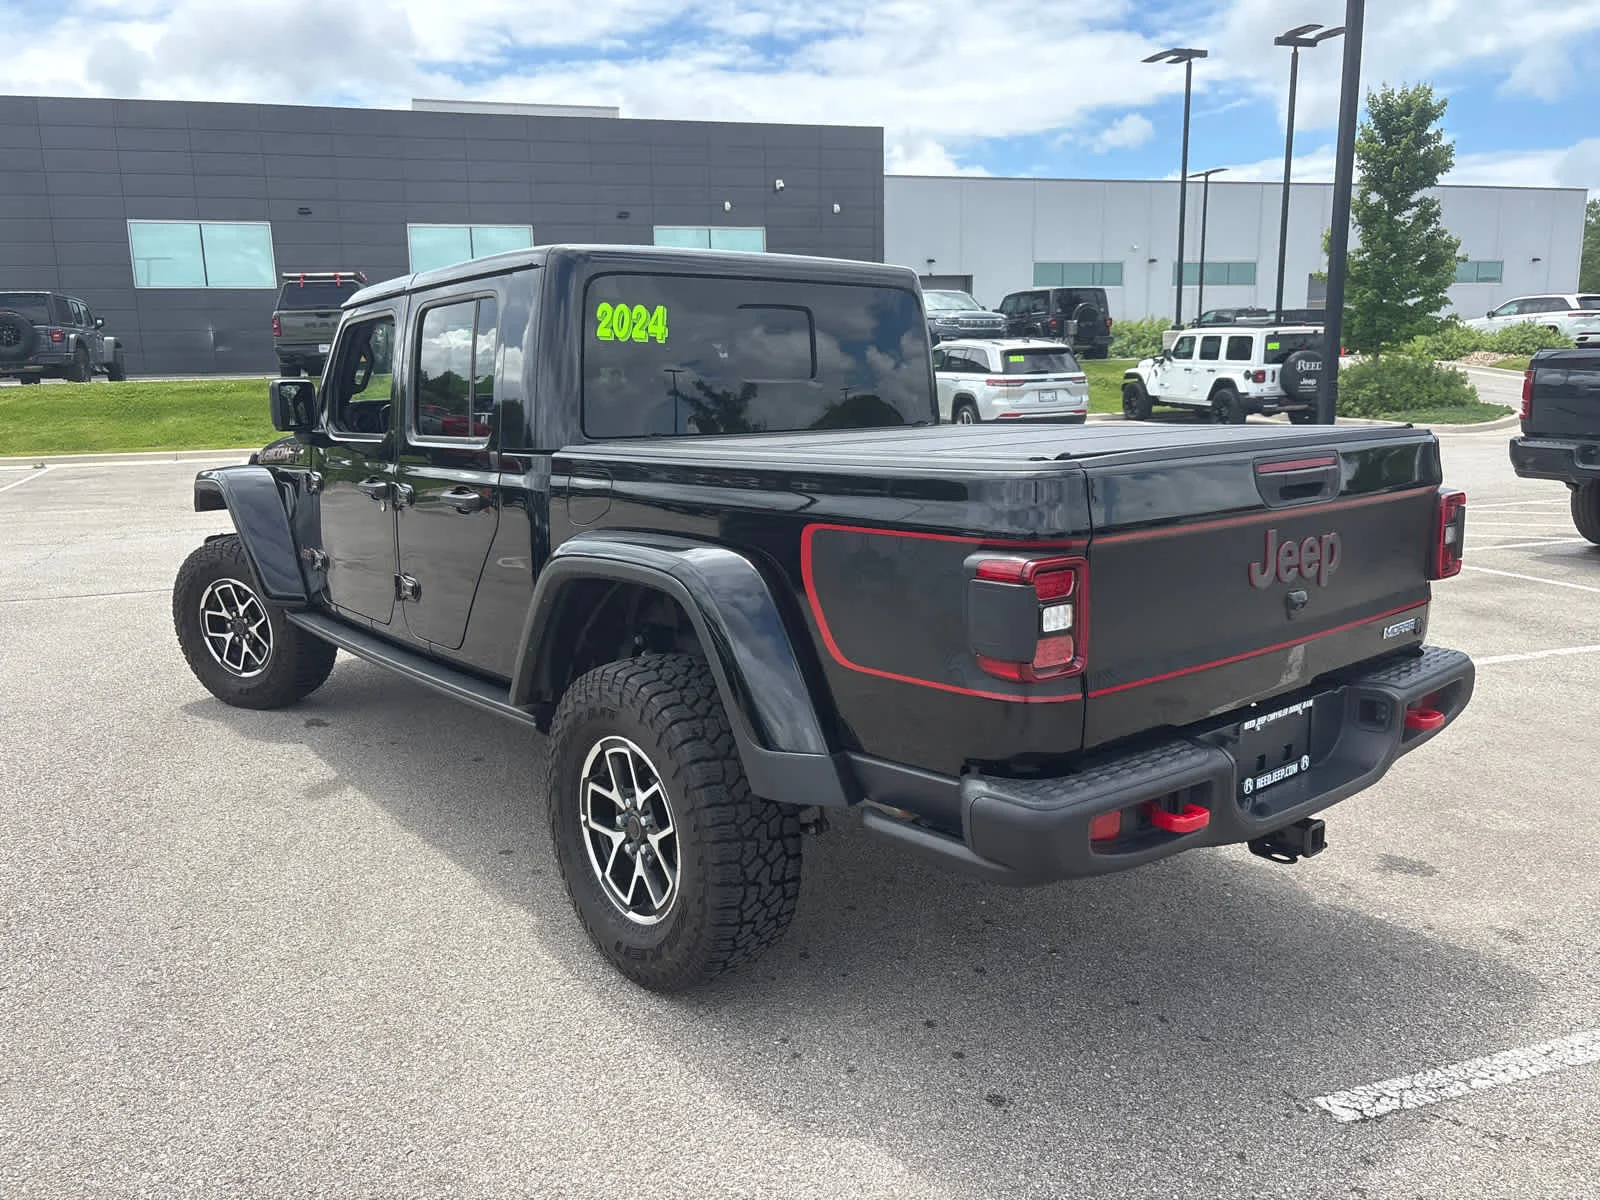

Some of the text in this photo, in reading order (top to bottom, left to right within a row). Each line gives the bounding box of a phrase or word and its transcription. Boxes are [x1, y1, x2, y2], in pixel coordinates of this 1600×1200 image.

[596, 302, 668, 343] 2024
[1300, 377, 1317, 386] Jeep
[1249, 529, 1341, 588] Jeep
[1256, 763, 1298, 789] REEDJEEP.COM
